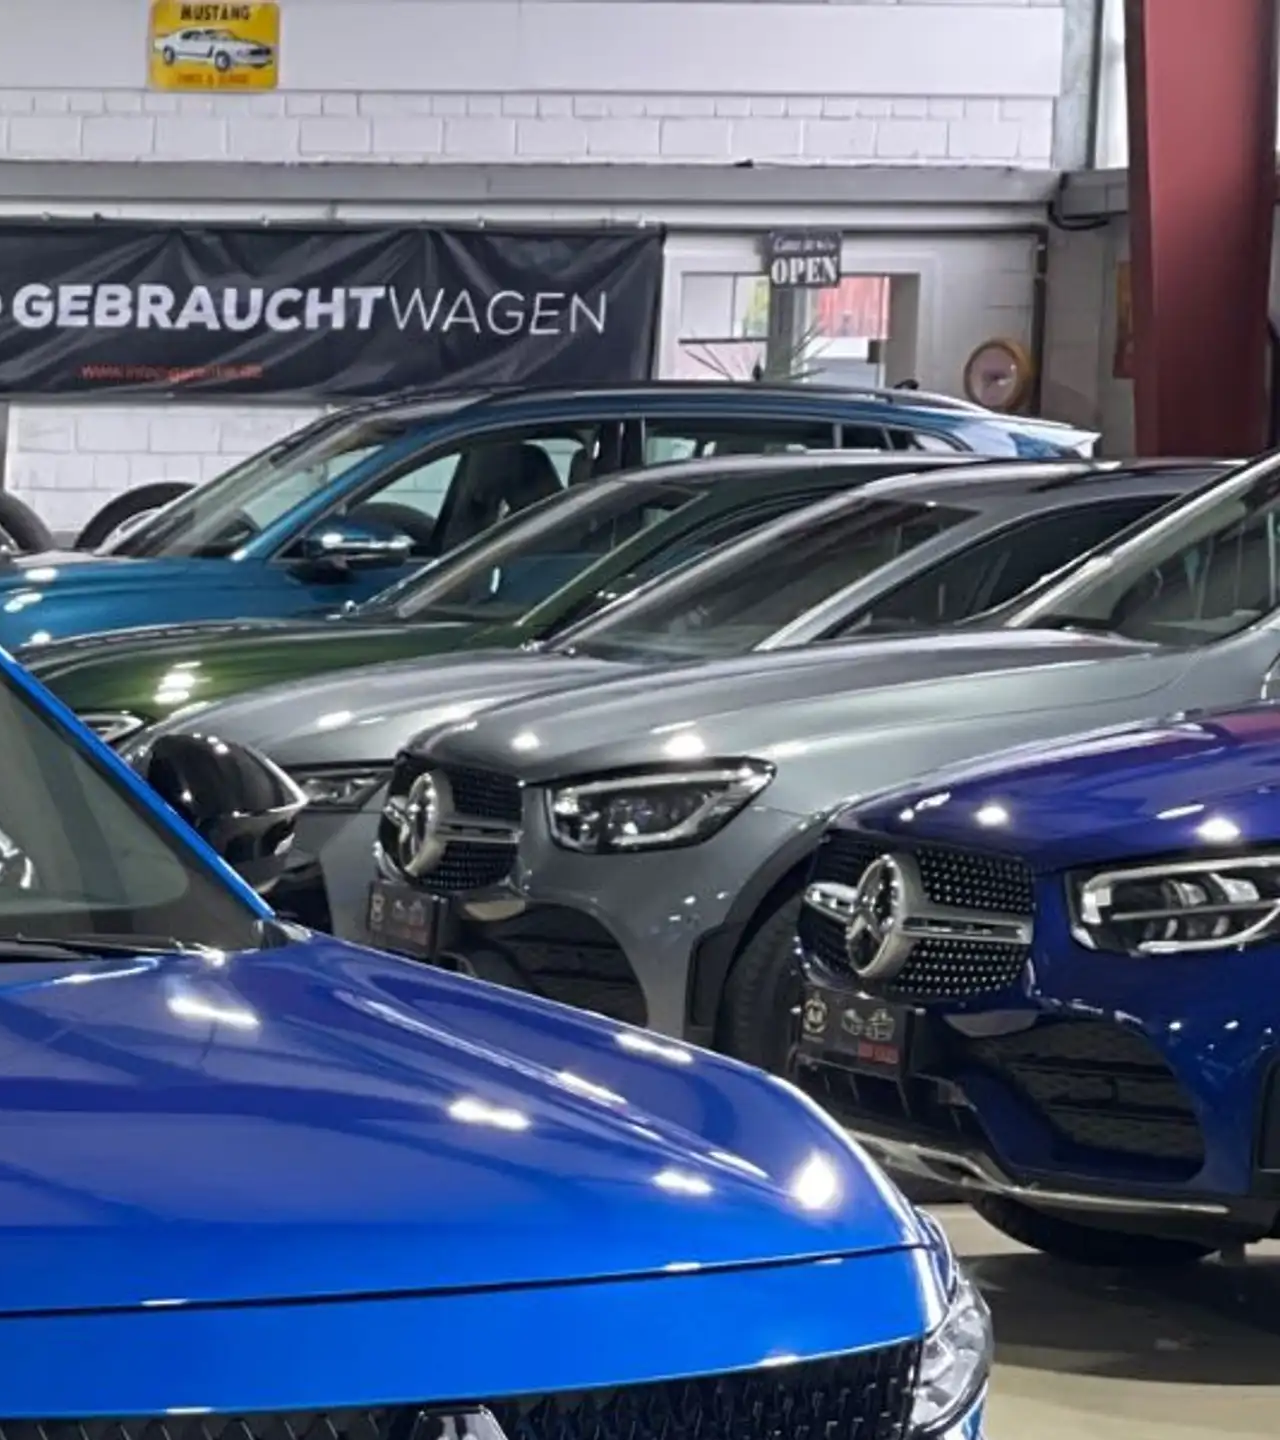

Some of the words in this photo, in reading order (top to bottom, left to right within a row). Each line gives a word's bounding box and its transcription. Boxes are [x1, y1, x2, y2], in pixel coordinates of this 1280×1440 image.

[181, 4, 250, 20] MUSTANG
[771, 257, 837, 284] OPEN
[12, 283, 608, 335] GEBRAUCHTWAGEN
